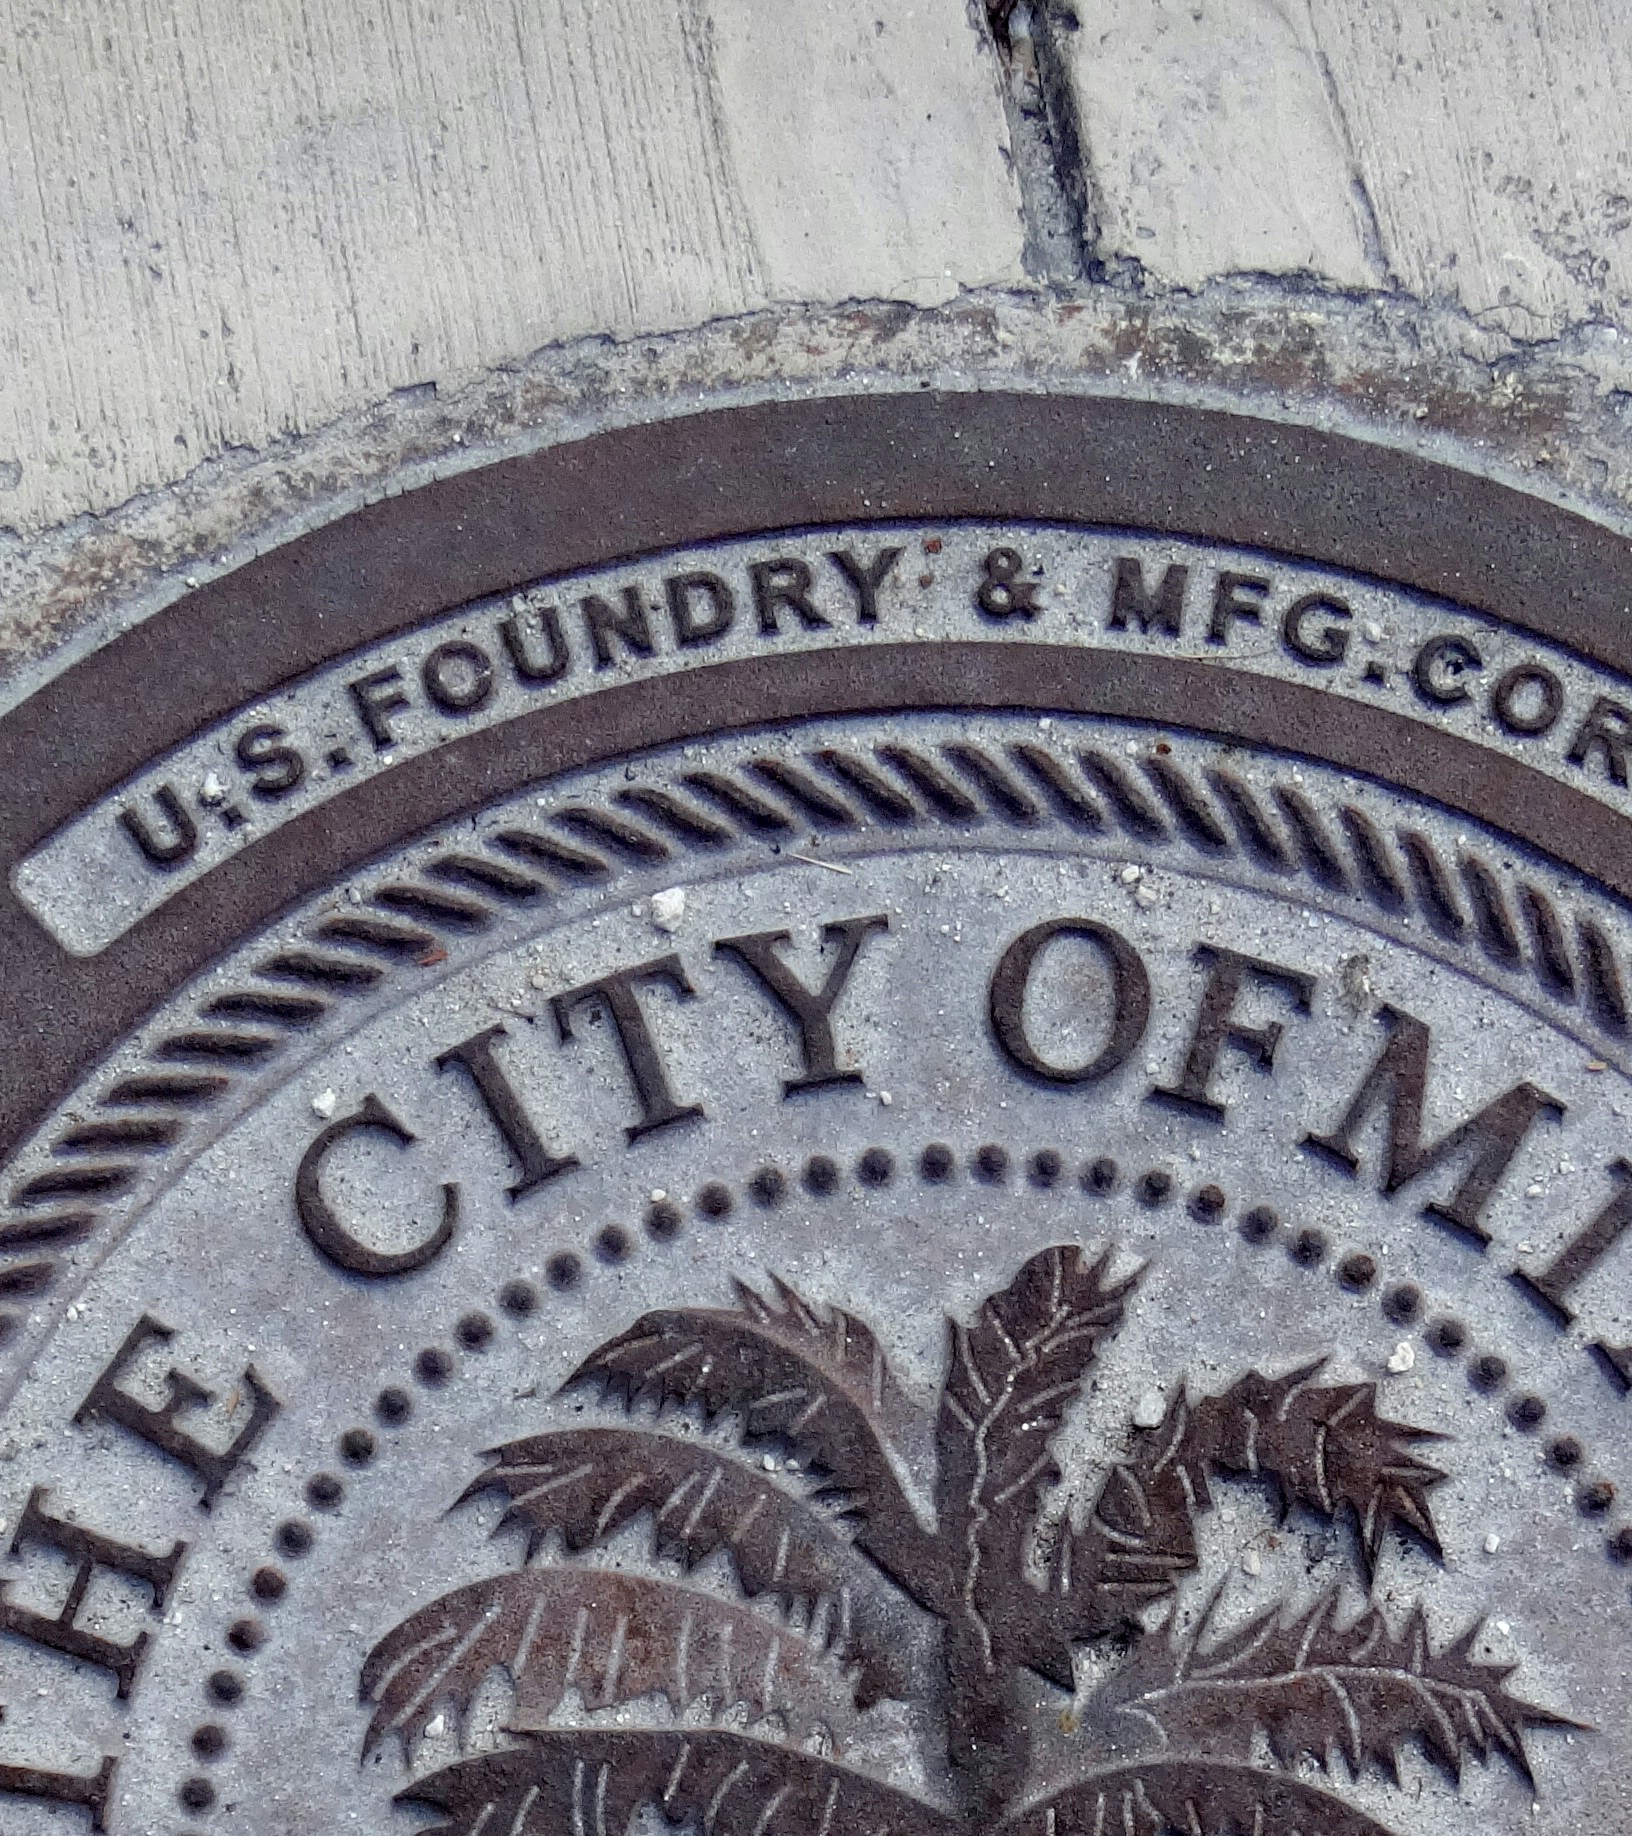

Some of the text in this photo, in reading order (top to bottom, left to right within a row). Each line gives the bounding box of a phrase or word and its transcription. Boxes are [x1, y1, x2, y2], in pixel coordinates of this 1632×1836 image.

[975, 544, 1044, 622] &
[294, 912, 891, 1281] CITY
[987, 915, 1319, 1123] OF
